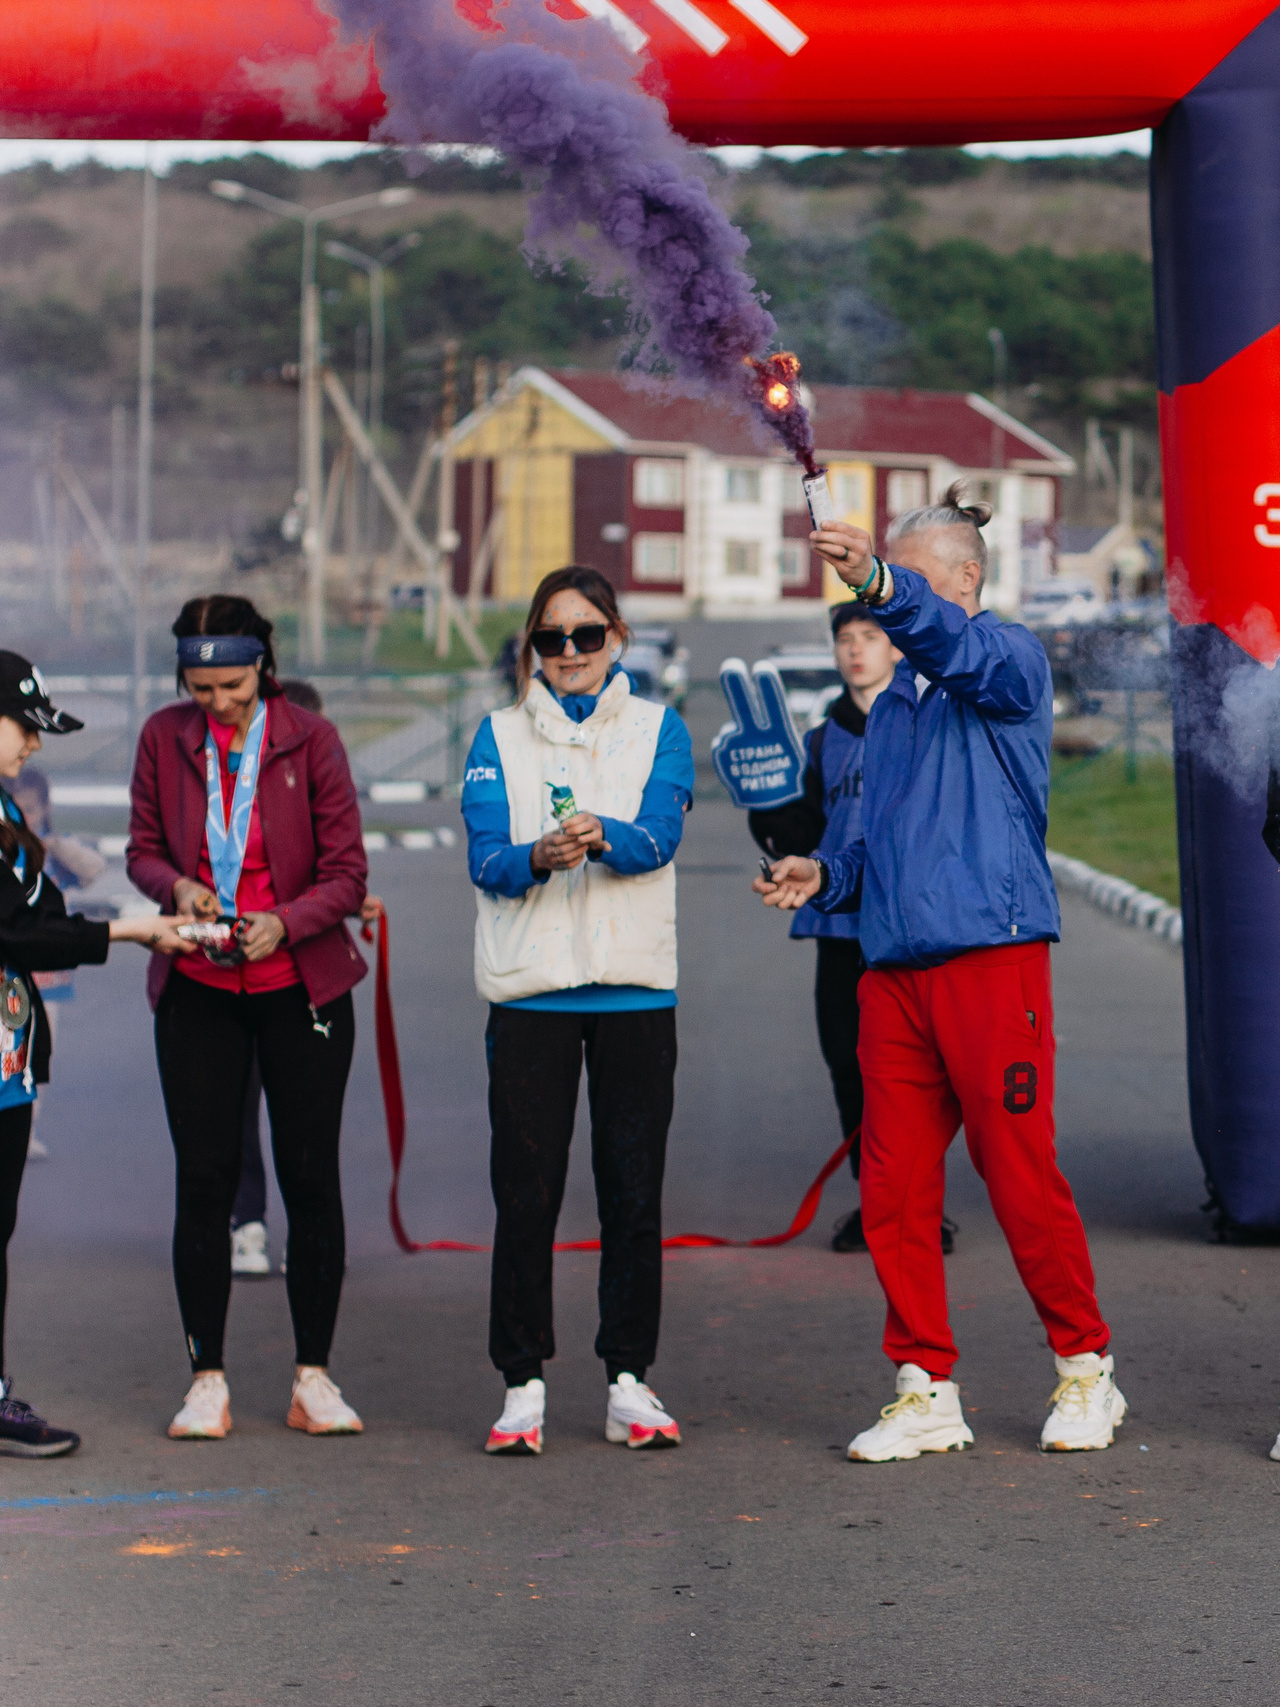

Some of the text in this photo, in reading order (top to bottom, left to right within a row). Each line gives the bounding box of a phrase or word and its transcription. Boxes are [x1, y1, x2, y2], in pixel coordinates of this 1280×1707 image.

[730, 742, 784, 761] СТРАНА
[741, 756, 791, 776] ОДНОМ
[740, 771, 787, 792] РИТМЕ
[1003, 1061, 1038, 1114] 8
